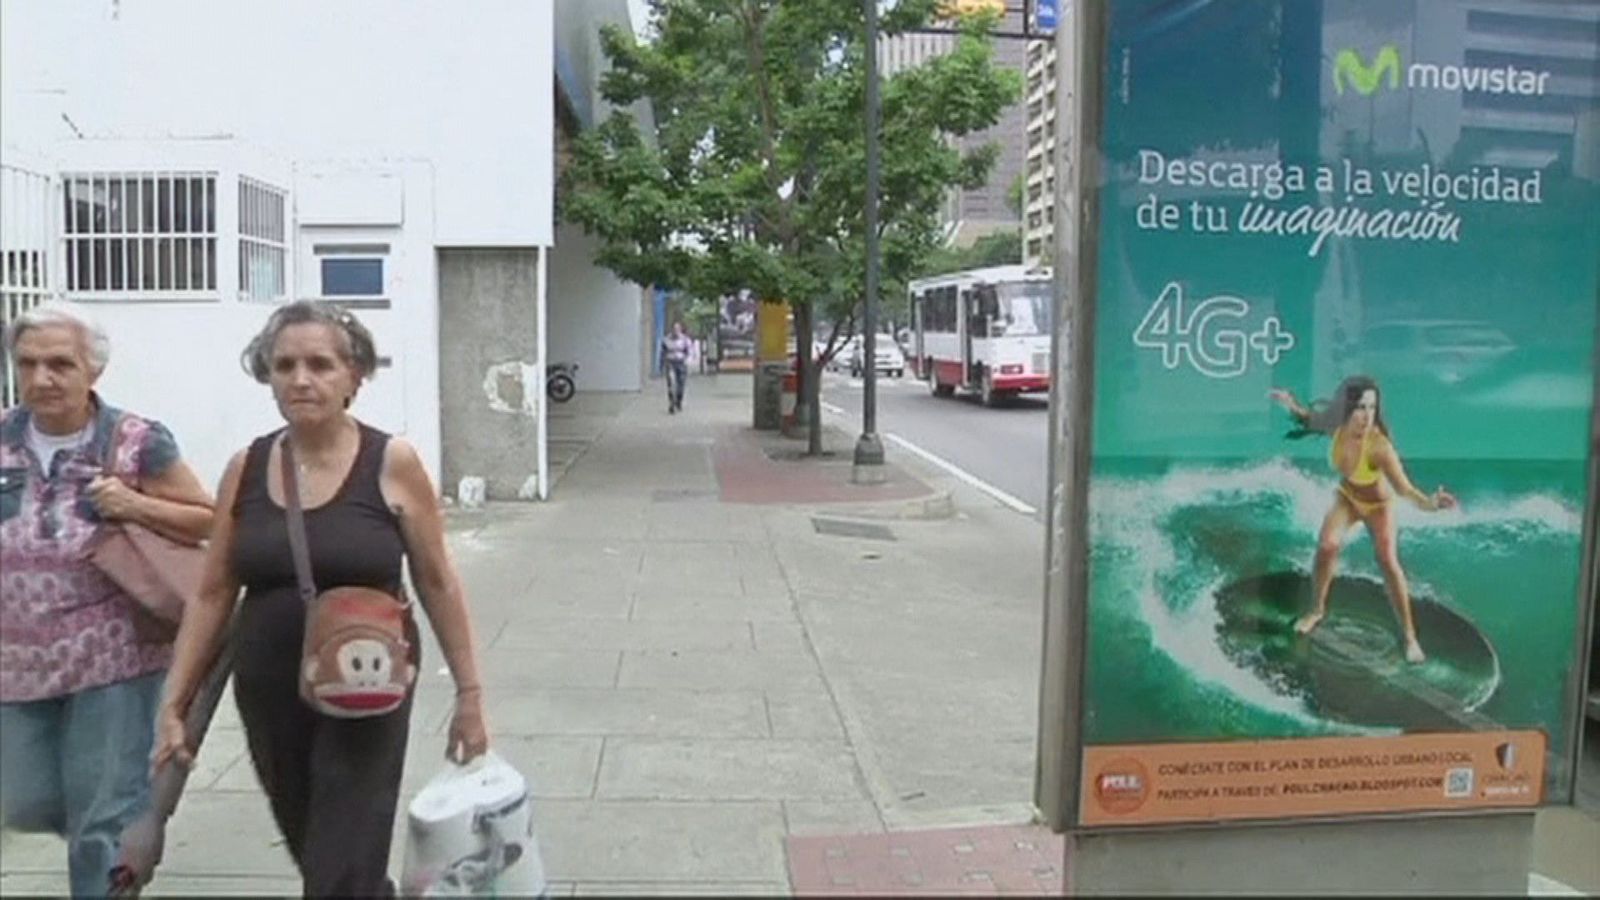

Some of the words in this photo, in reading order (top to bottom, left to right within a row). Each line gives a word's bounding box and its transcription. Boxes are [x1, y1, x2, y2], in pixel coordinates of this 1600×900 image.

[1407, 62, 1549, 95] movistar
[1138, 149, 1305, 200] Descarga
[1314, 166, 1334, 192] a
[1342, 158, 1374, 195] la
[1382, 163, 1543, 204] velocidad
[1136, 193, 1180, 229] de
[1190, 200, 1229, 233] tu
[1238, 190, 1461, 258] imaginación
[1132, 281, 1295, 378] 4G+
